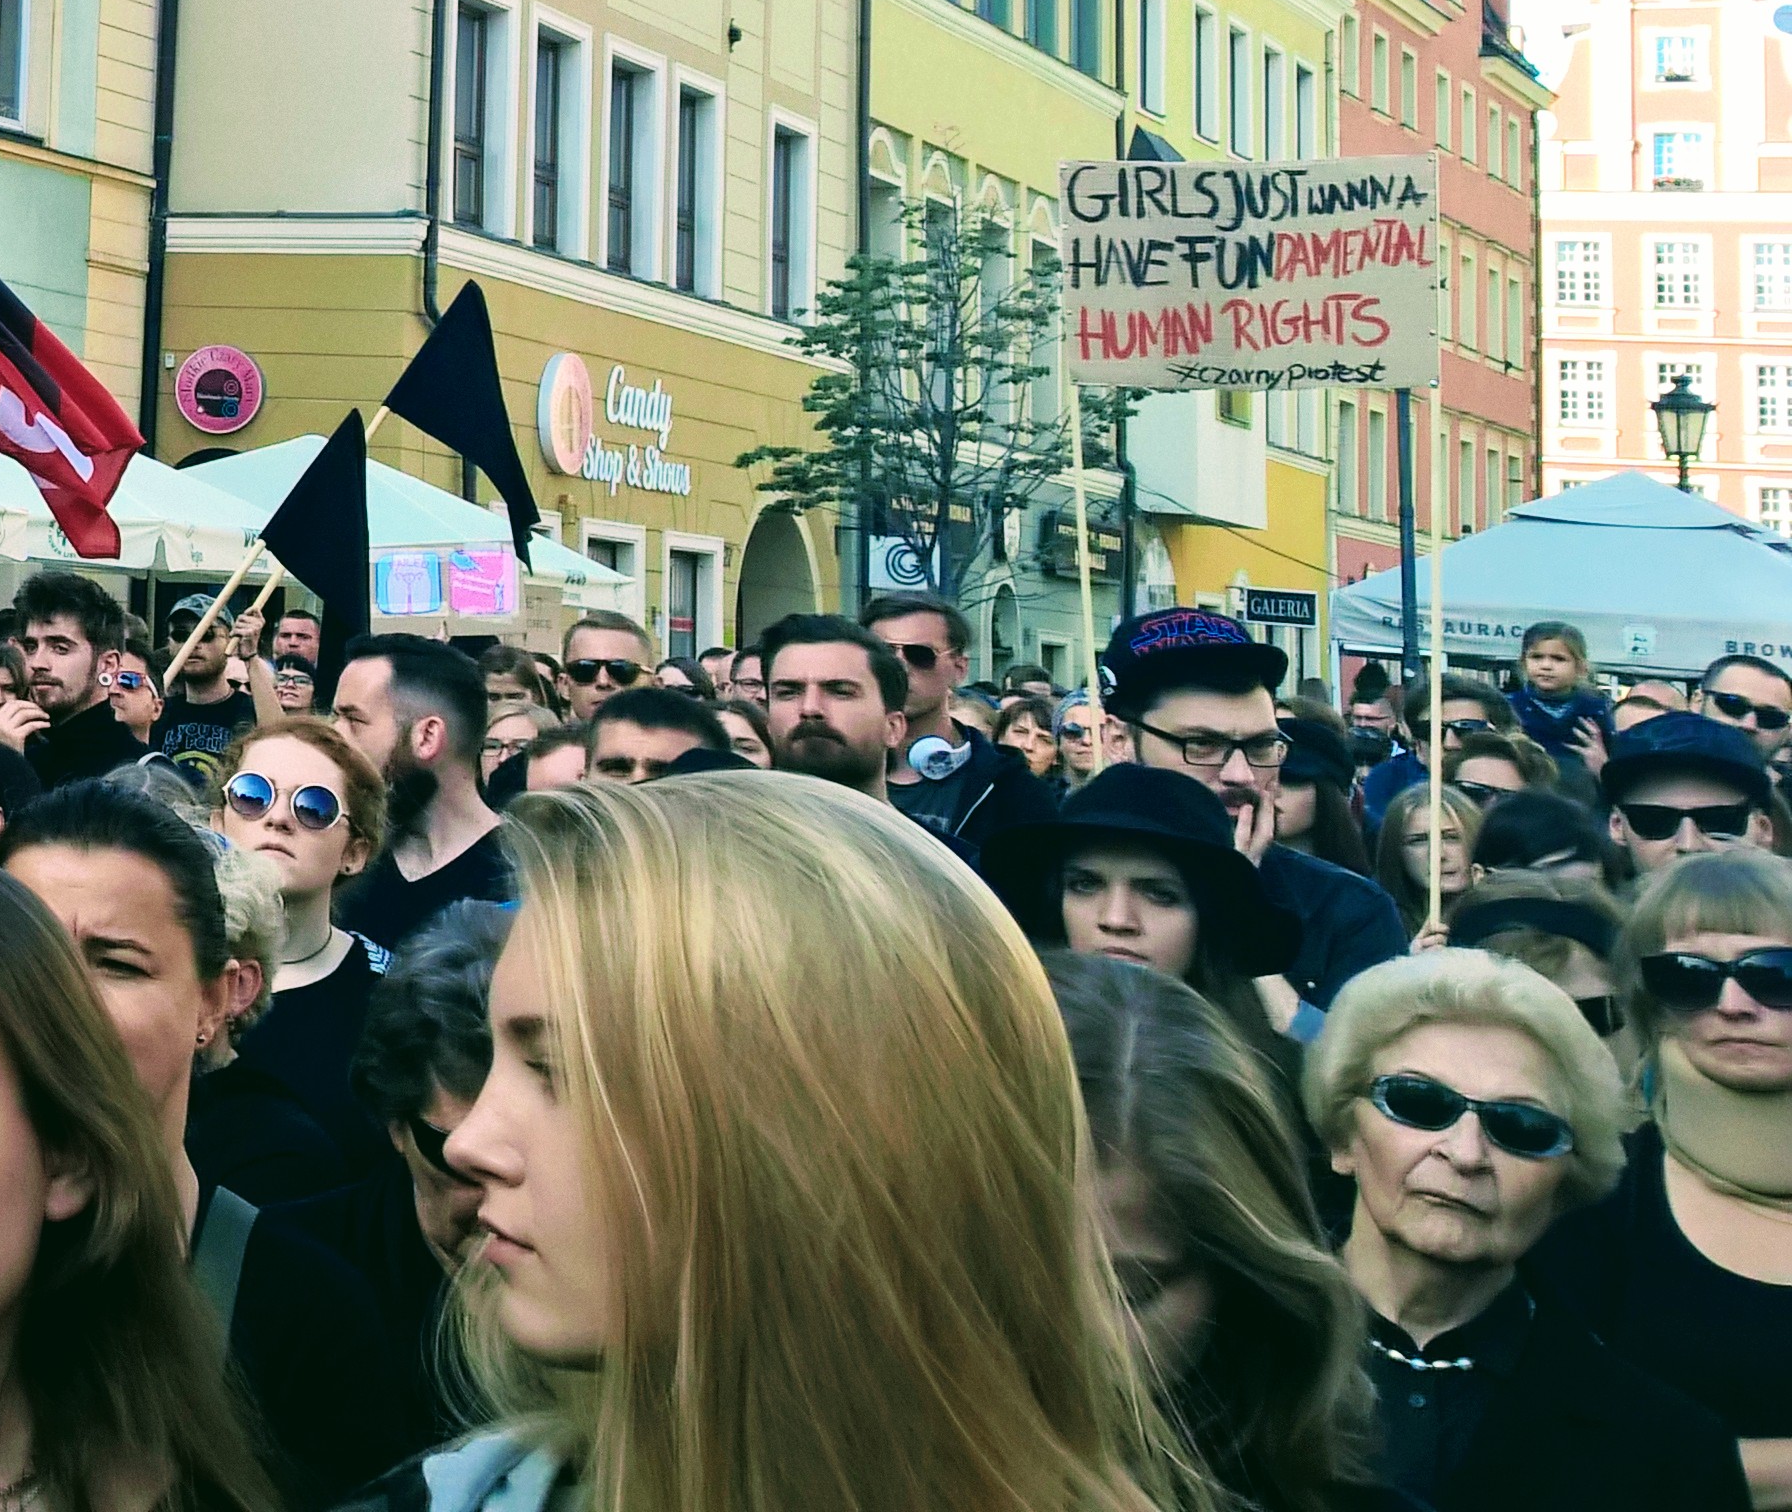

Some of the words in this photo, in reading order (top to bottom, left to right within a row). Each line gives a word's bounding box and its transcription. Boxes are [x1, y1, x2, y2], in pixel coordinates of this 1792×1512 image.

[1067, 165, 1218, 223] GIRLS
[1216, 169, 1308, 231] JUST
[1307, 174, 1429, 216] WANNA
[1068, 234, 1175, 289] HAVE
[1175, 219, 1434, 290] FUNDAMENTAL
[1075, 299, 1213, 360] HUMAN
[1220, 294, 1391, 352] RIGHTS
[605, 365, 673, 451] Candy
[582, 433, 624, 497] Shop
[626, 444, 642, 488] &
[643, 445, 691, 496] Shows
[1130, 612, 1247, 650] STAR
[1251, 597, 1311, 619] GALERIA
